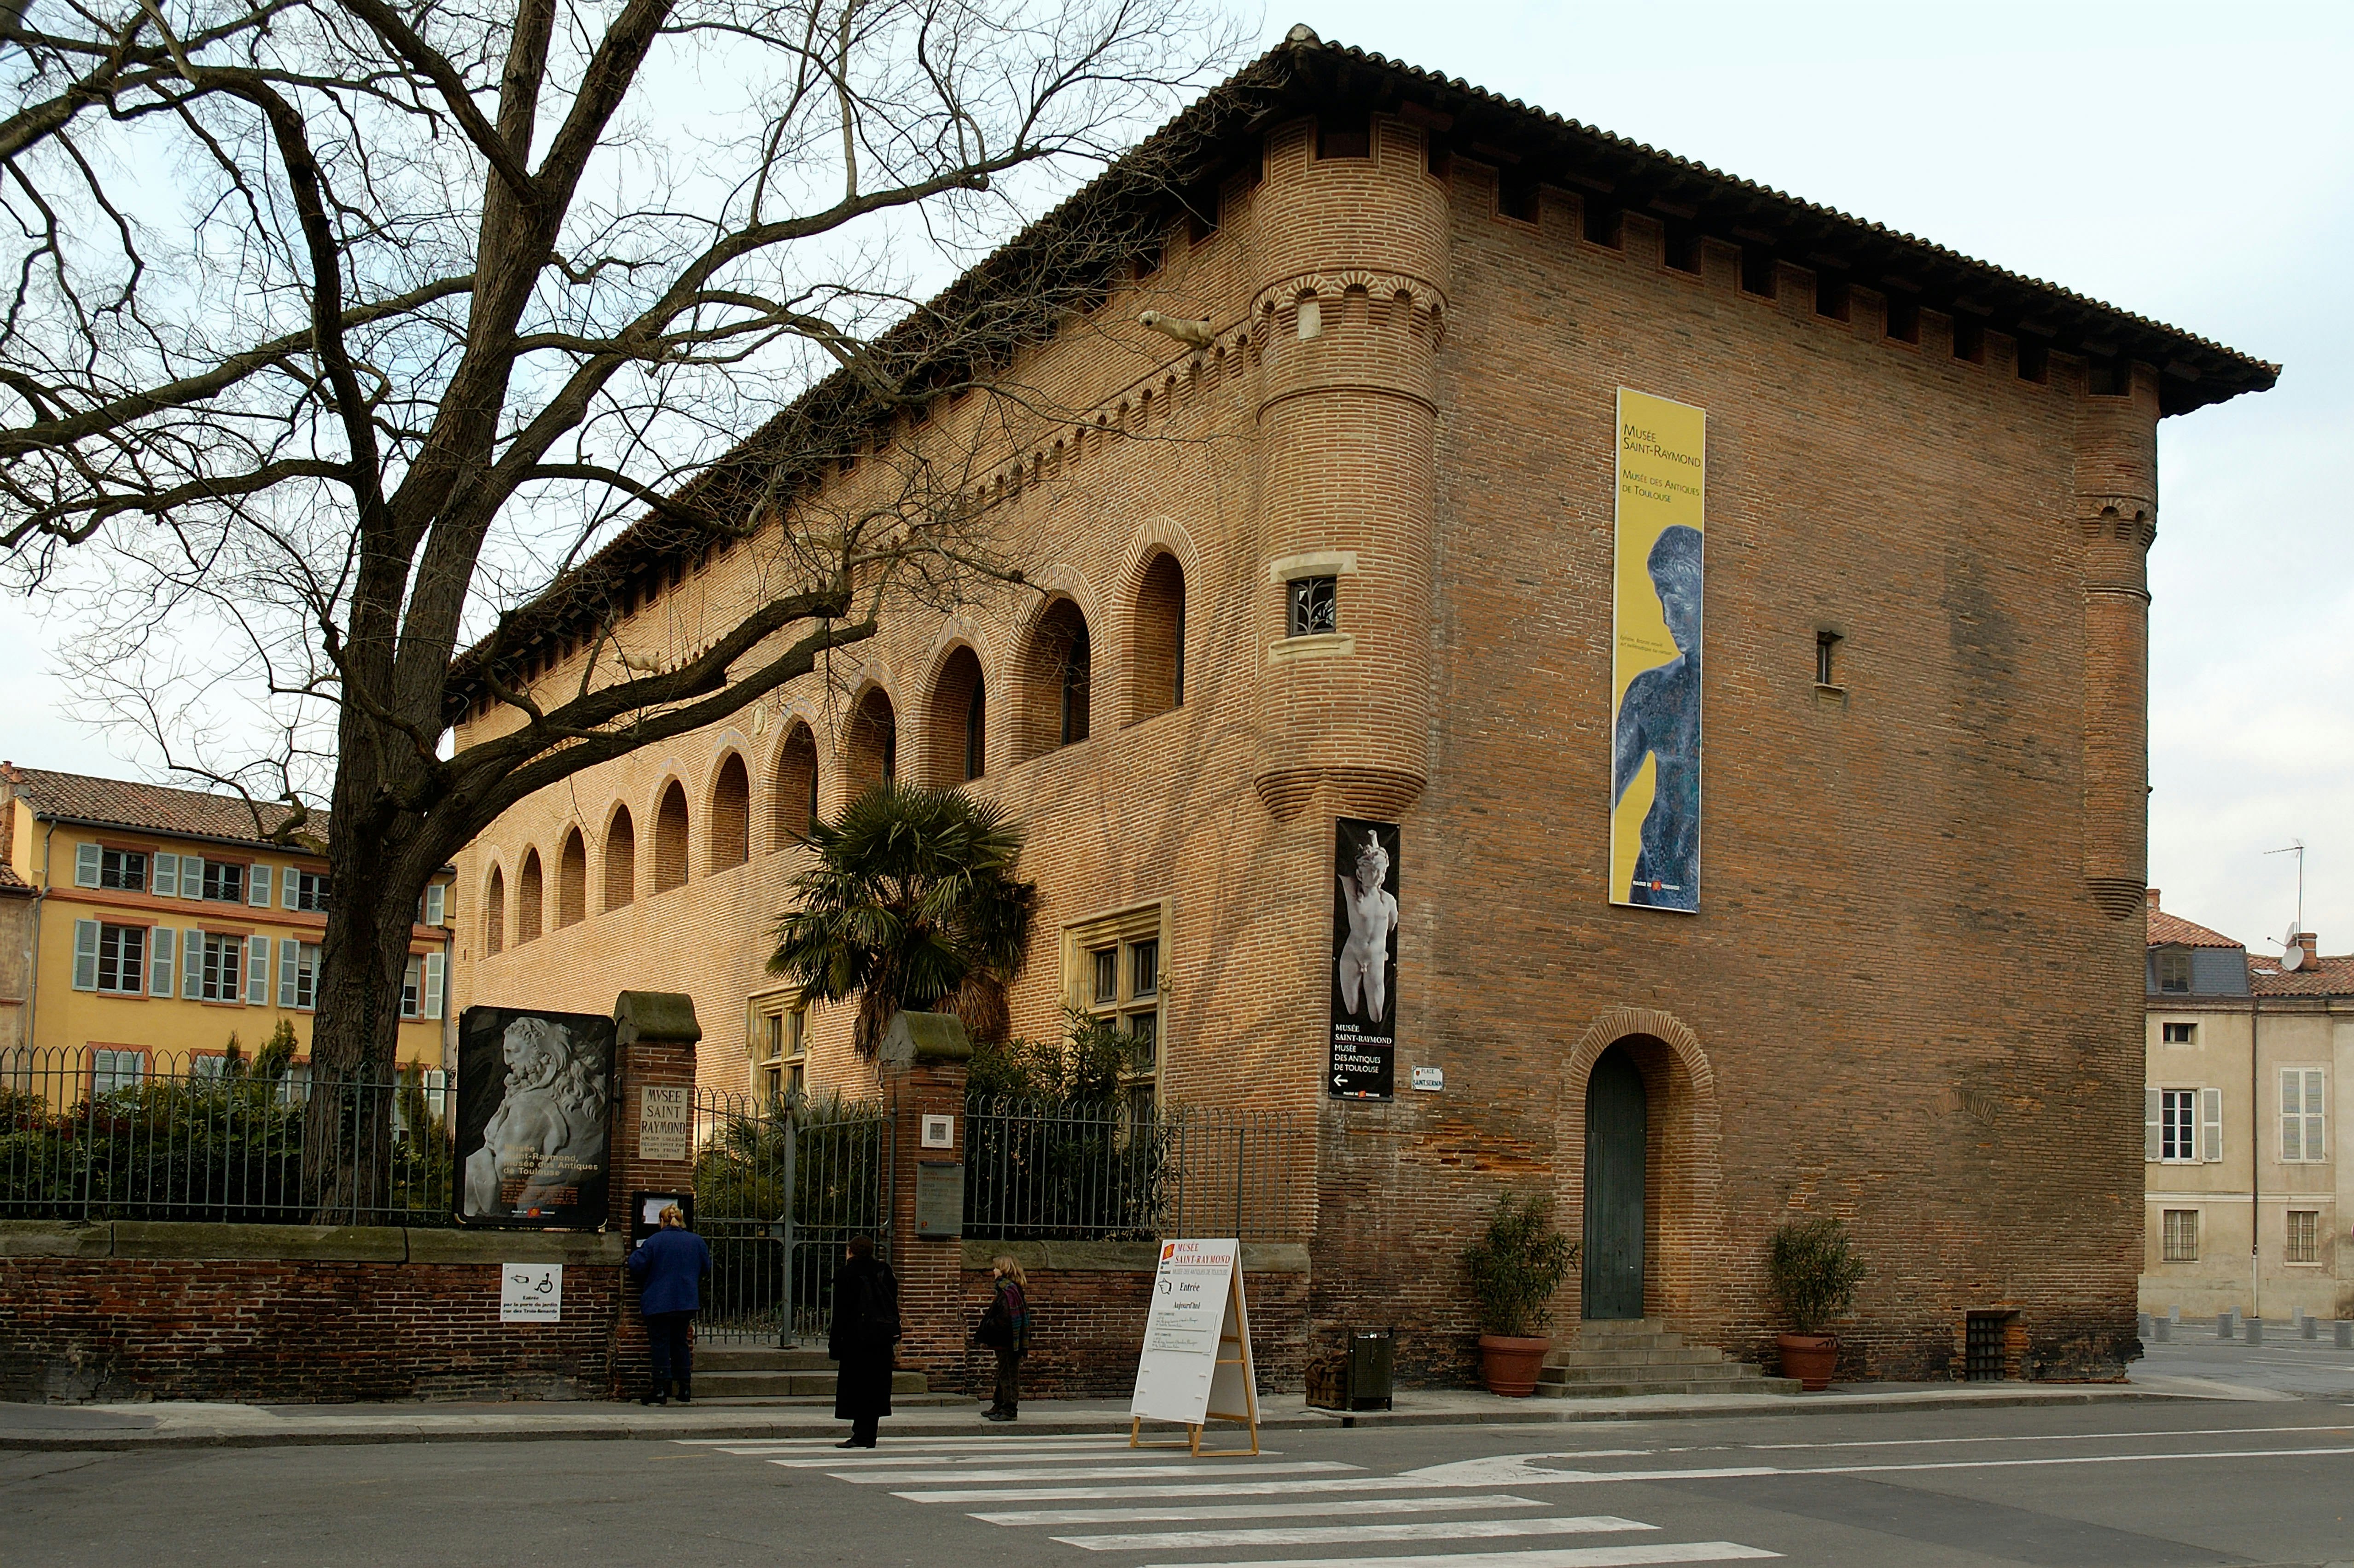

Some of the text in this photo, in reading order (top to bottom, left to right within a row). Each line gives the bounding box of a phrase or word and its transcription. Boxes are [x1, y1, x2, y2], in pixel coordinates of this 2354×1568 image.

[1623, 437, 1701, 467] SAINT-RAYMOND
[1336, 1024, 1360, 1032] MUSÉE
[1335, 1034, 1392, 1044] SAINT-RAYMOND
[1335, 1044, 1357, 1052] MUSÉE
[1348, 1055, 1381, 1064] ANTIQUES
[1344, 1064, 1379, 1073] TOULOUSE
[647, 1089, 682, 1103] MVSEE
[647, 1105, 681, 1118] SAINT
[641, 1121, 686, 1134] RAYMOND
[505, 1144, 535, 1152] Musée
[558, 1162, 598, 1171] Antiques
[518, 1167, 560, 1176] Toulouse
[1177, 1241, 1199, 1252] MUSÉE
[1180, 1282, 1200, 1292] Entrée
